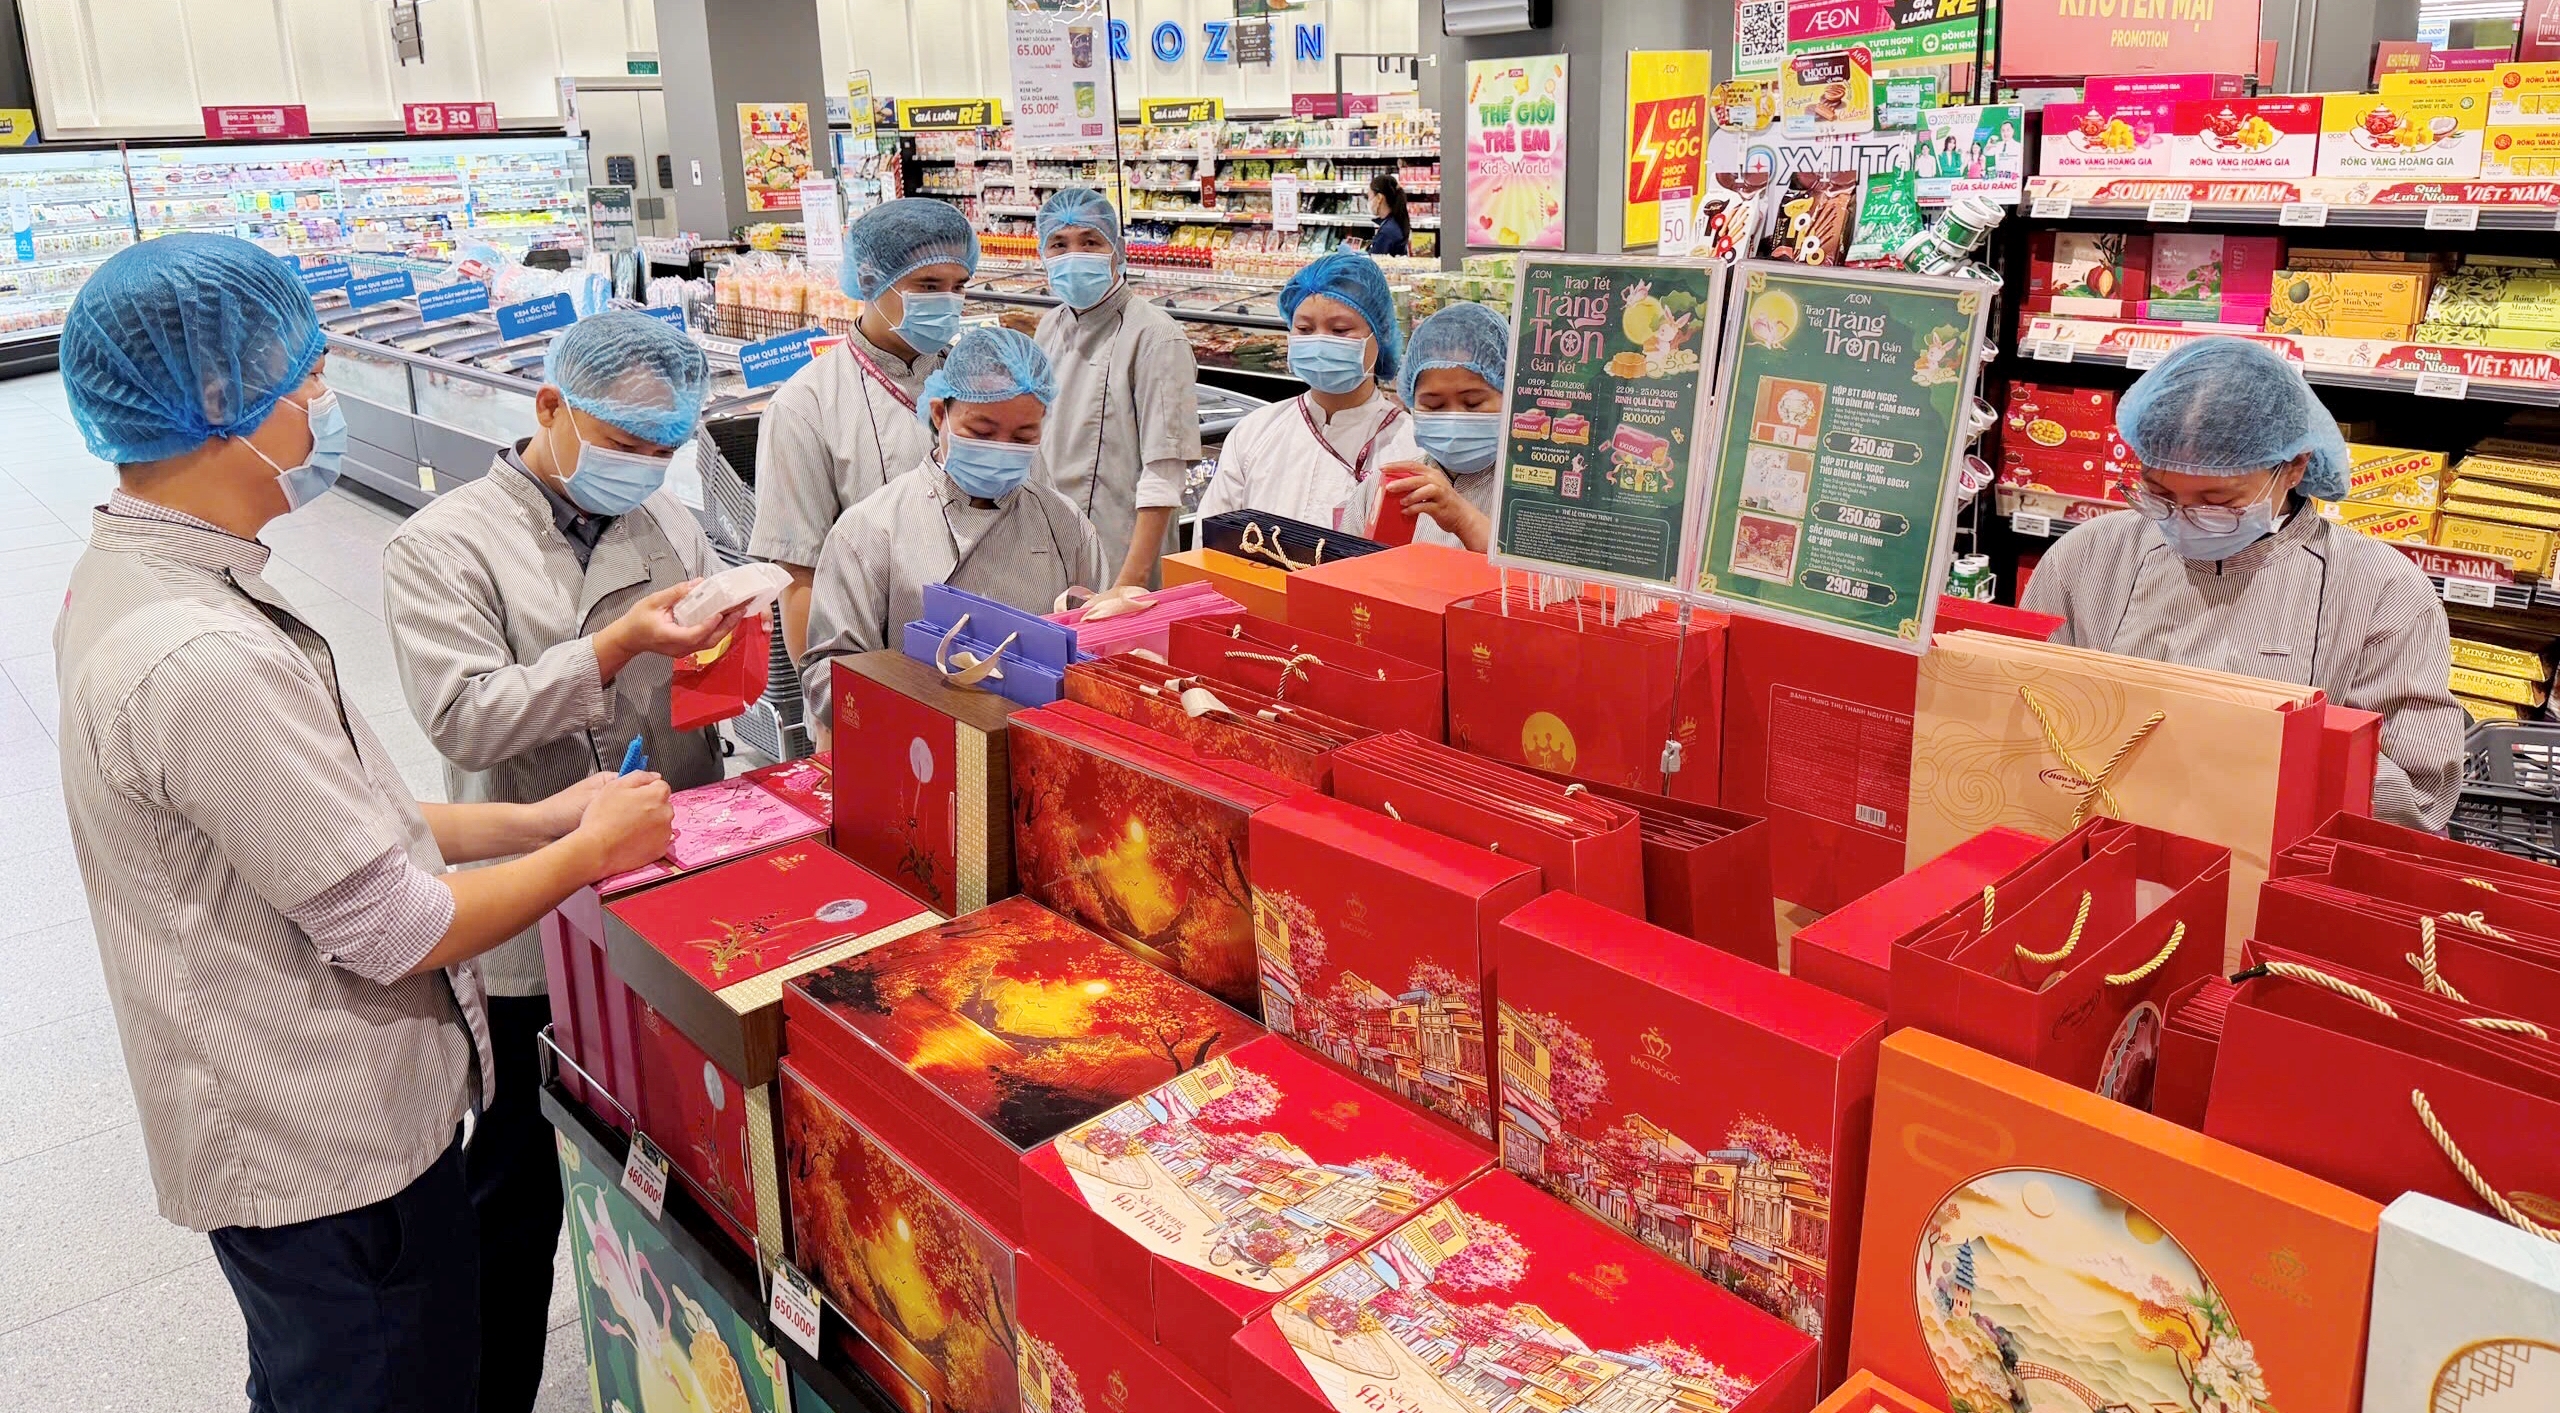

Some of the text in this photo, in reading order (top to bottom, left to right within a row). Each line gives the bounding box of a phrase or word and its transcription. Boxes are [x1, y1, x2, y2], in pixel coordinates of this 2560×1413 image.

[1869, 36, 1914, 48] TƯƠI NGON
[1960, 40, 1977, 50] NHÀ
[2110, 29, 2169, 48] PROMOTION
[1802, 64, 1844, 78] CHOCOLAT
[915, 99, 984, 125] GIÁ LUÔN RẺ
[1153, 99, 1210, 121] GIÁ LUÔN RẺ
[1479, 94, 1555, 127] THẾ GIỚI
[1668, 101, 1697, 130] GIÁ
[1936, 113, 1978, 126] XYLITOL
[1483, 124, 1550, 153] TRẺ EM
[1664, 130, 1700, 160] SỐC
[1480, 161, 1549, 175] Kid's World
[1662, 164, 1686, 176] SHOCK
[2084, 156, 2105, 166] VÀNG
[2107, 156, 2136, 166] HOÀNG
[2138, 157, 2153, 166] GIA
[2216, 156, 2239, 166] VÀNG
[2241, 156, 2271, 166] HOÀNG
[2273, 157, 2290, 166] GIA
[2371, 156, 2396, 166] VÀNG
[2399, 156, 2434, 166] HOÀNG
[2437, 157, 2454, 166] GIA
[1661, 176, 1681, 188] PRICE
[1971, 181, 2017, 192] SÂU RĂNG
[2109, 182, 2194, 200] SOUVENIR
[2414, 184, 2441, 194] Quà
[1867, 202, 1912, 219] XYLITOL
[354, 282, 368, 292] KEM
[368, 280, 380, 289] QUE
[1564, 275, 1611, 290] Trao Tết
[514, 301, 557, 318] KEM ỐC QUẾ
[1533, 287, 1610, 329] Trăng
[1804, 304, 1825, 316] Trao
[525, 314, 542, 322] CREAM
[1807, 315, 1824, 327] Tết
[1826, 306, 1887, 338] Trăng
[1529, 318, 1605, 364] Tròn
[1822, 327, 1880, 363] Tròn
[743, 342, 803, 364] KEM QUE NHẬP
[750, 350, 810, 371] IMPORTED ICE CREAM
[2414, 349, 2442, 361] Quà
[1833, 385, 1847, 396] HỘP
[1847, 388, 1861, 398] BTT
[1876, 392, 1898, 403] NGỌC
[1831, 396, 1844, 405] THU
[1863, 401, 1874, 410] AN
[1879, 403, 1897, 414] CAM
[1849, 437, 1894, 459] 250.000
[1821, 455, 1835, 466] HỘP
[1835, 458, 1848, 468] BTT
[2381, 456, 2433, 481] NGỌC
[1819, 466, 1832, 475] THU
[1851, 471, 1862, 480] AN
[1866, 474, 1886, 485] XANH
[2517, 467, 2541, 478] MINH
[1837, 507, 1881, 529] 250.000
[2371, 515, 2420, 536] NGỌC
[1809, 523, 1823, 535] SẮC
[1848, 531, 1859, 542] HÀ
[2453, 540, 2491, 554] MINH
[1825, 575, 1868, 599] 290.000
[2461, 647, 2524, 666] MINH NGỌC
[2454, 672, 2482, 683] MINH
[1808, 696, 1829, 706] TRUNG
[1831, 701, 1844, 710] THU
[1845, 704, 1866, 716] THANH
[1867, 708, 1893, 722] NGUYỆT
[627, 1165, 662, 1204] 460.000đ
[773, 1295, 816, 1339] 650.000đ
